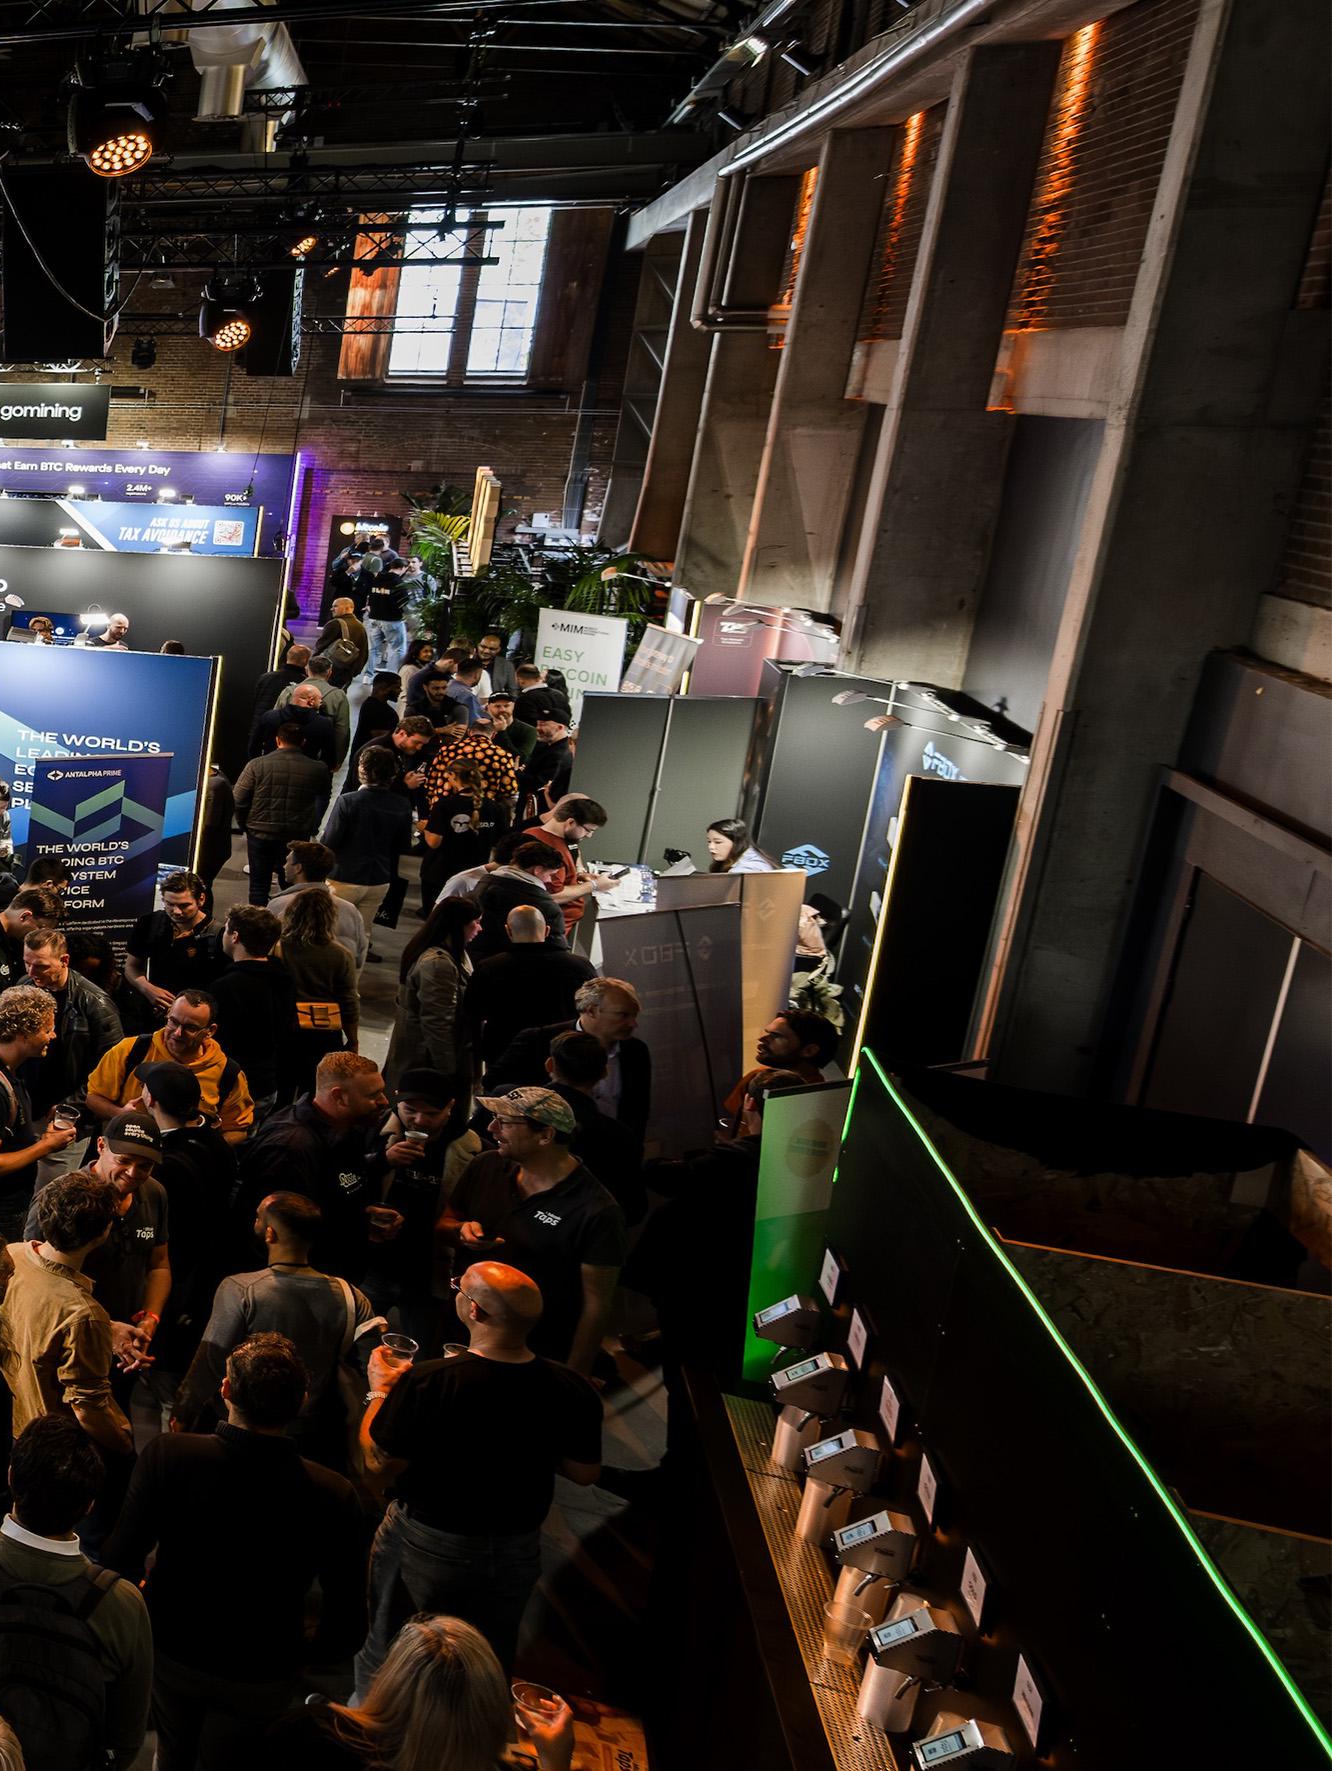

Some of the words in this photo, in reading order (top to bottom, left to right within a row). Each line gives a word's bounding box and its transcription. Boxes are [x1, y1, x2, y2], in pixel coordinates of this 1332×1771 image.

[0, 402, 82, 422] gomining
[14, 461, 37, 471] Earn
[40, 462, 63, 472] BTC
[65, 463, 112, 474] Rewards
[114, 464, 146, 476] Every
[148, 465, 170, 477] Day
[150, 518, 167, 528] ASK
[119, 527, 140, 541] TAX
[560, 623, 584, 634] MIM
[542, 646, 584, 662] EASY
[16, 728, 58, 745] THE
[62, 733, 161, 754] WORLD'S
[65, 770, 103, 778] ANTALPHA
[103, 769, 121, 777] PRIME
[36, 845, 64, 854] THE
[67, 841, 129, 852] WORLD'S
[98, 855, 124, 865] BTC
[781, 855, 830, 867] FBOX
[71, 870, 116, 881] YSTEM
